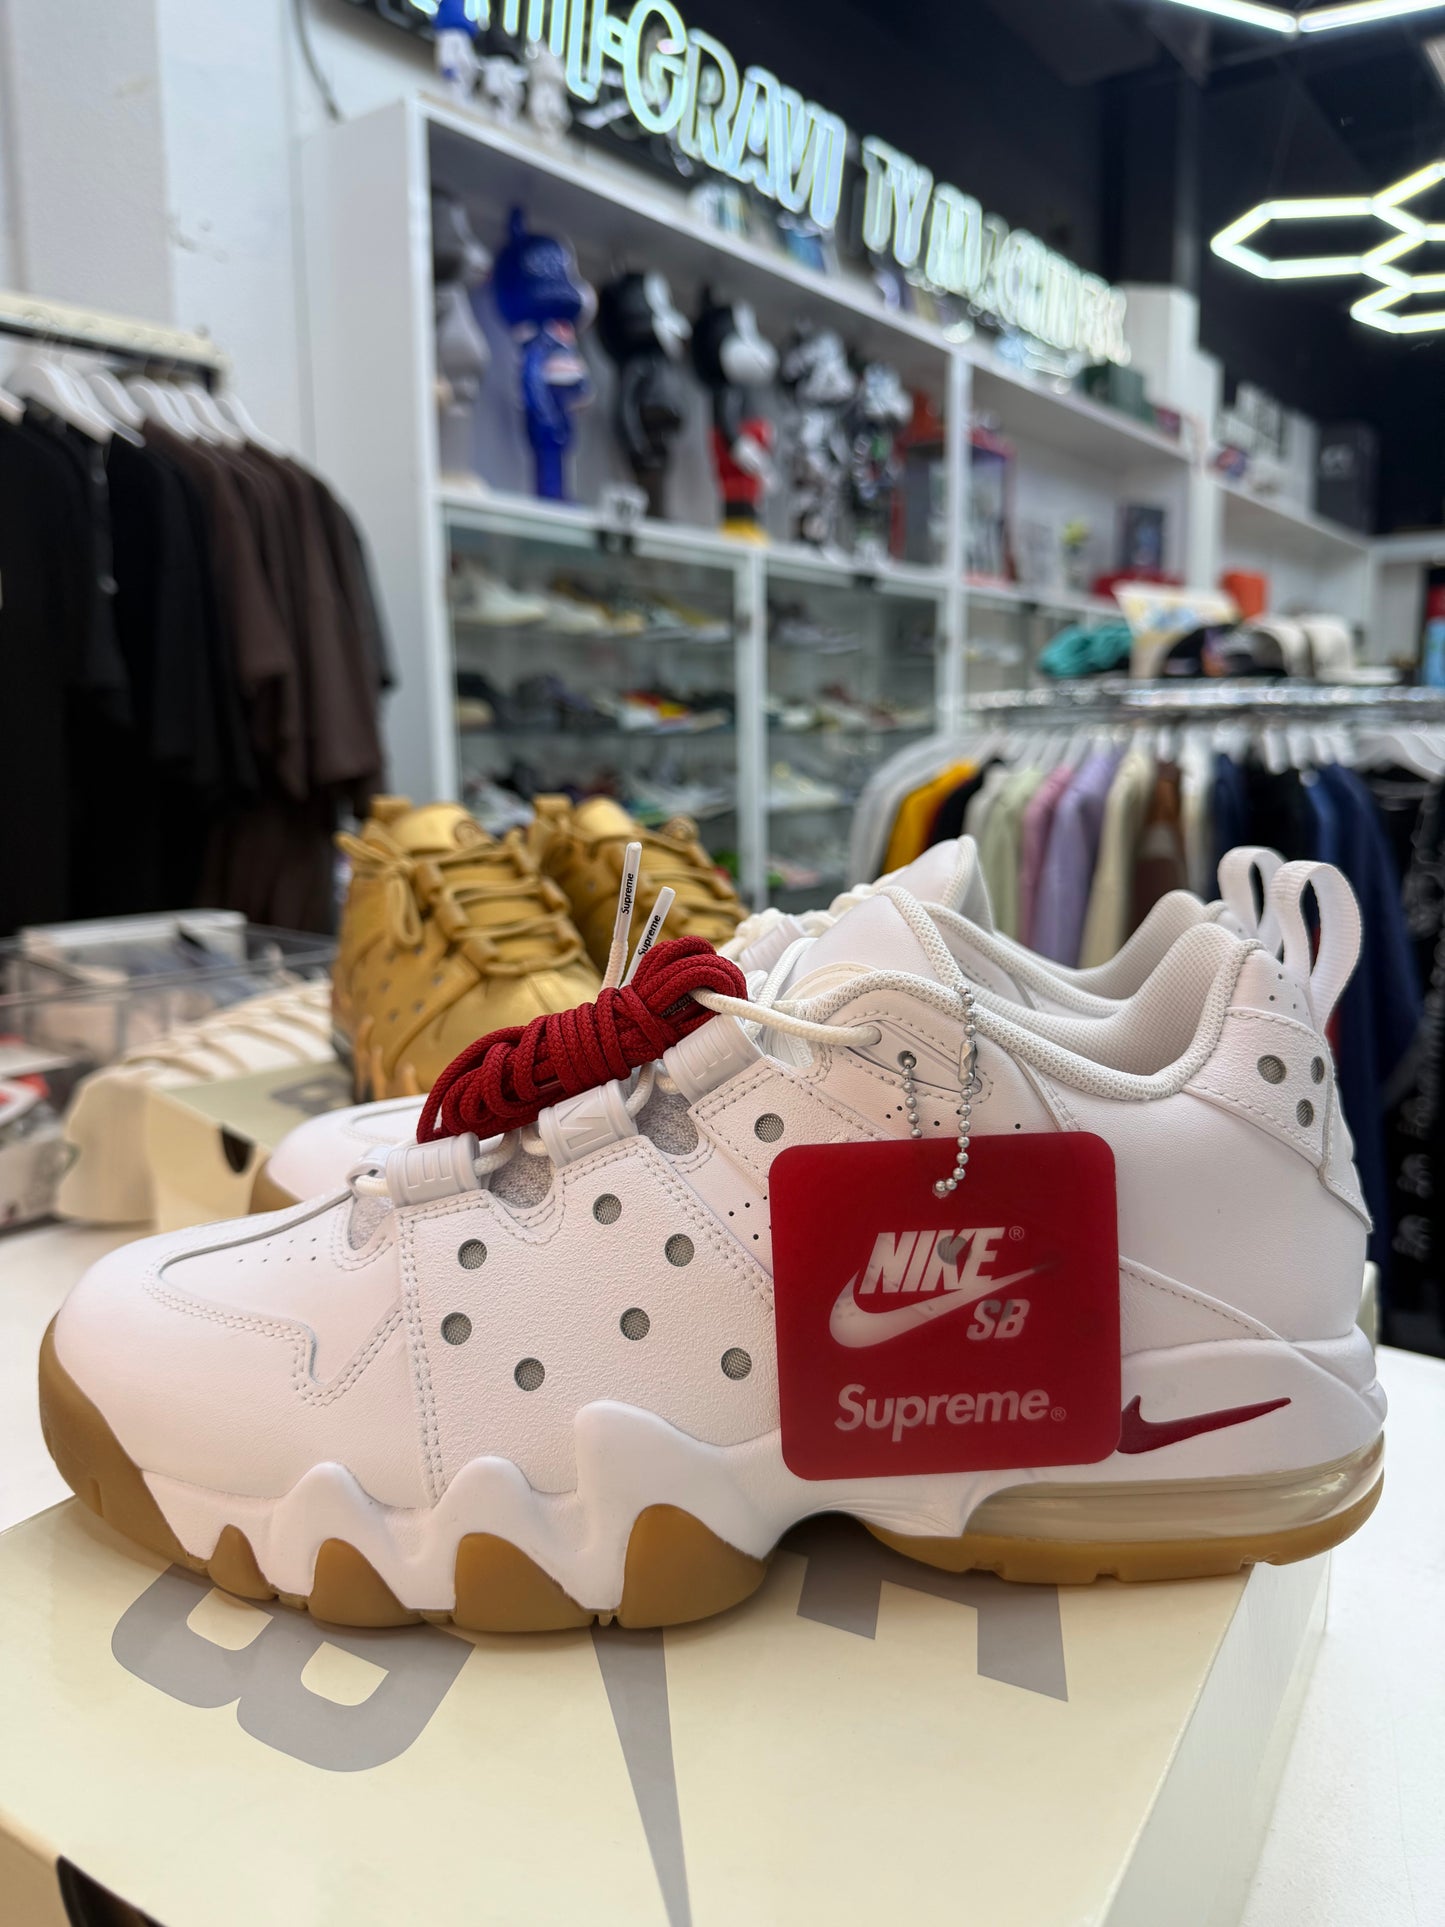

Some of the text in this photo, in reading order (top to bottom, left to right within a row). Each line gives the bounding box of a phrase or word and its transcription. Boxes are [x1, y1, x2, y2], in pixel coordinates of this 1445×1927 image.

[621, 872, 634, 915] Supreme
[638, 914, 661, 956] Supreme
[966, 1299, 1031, 1341] SB
